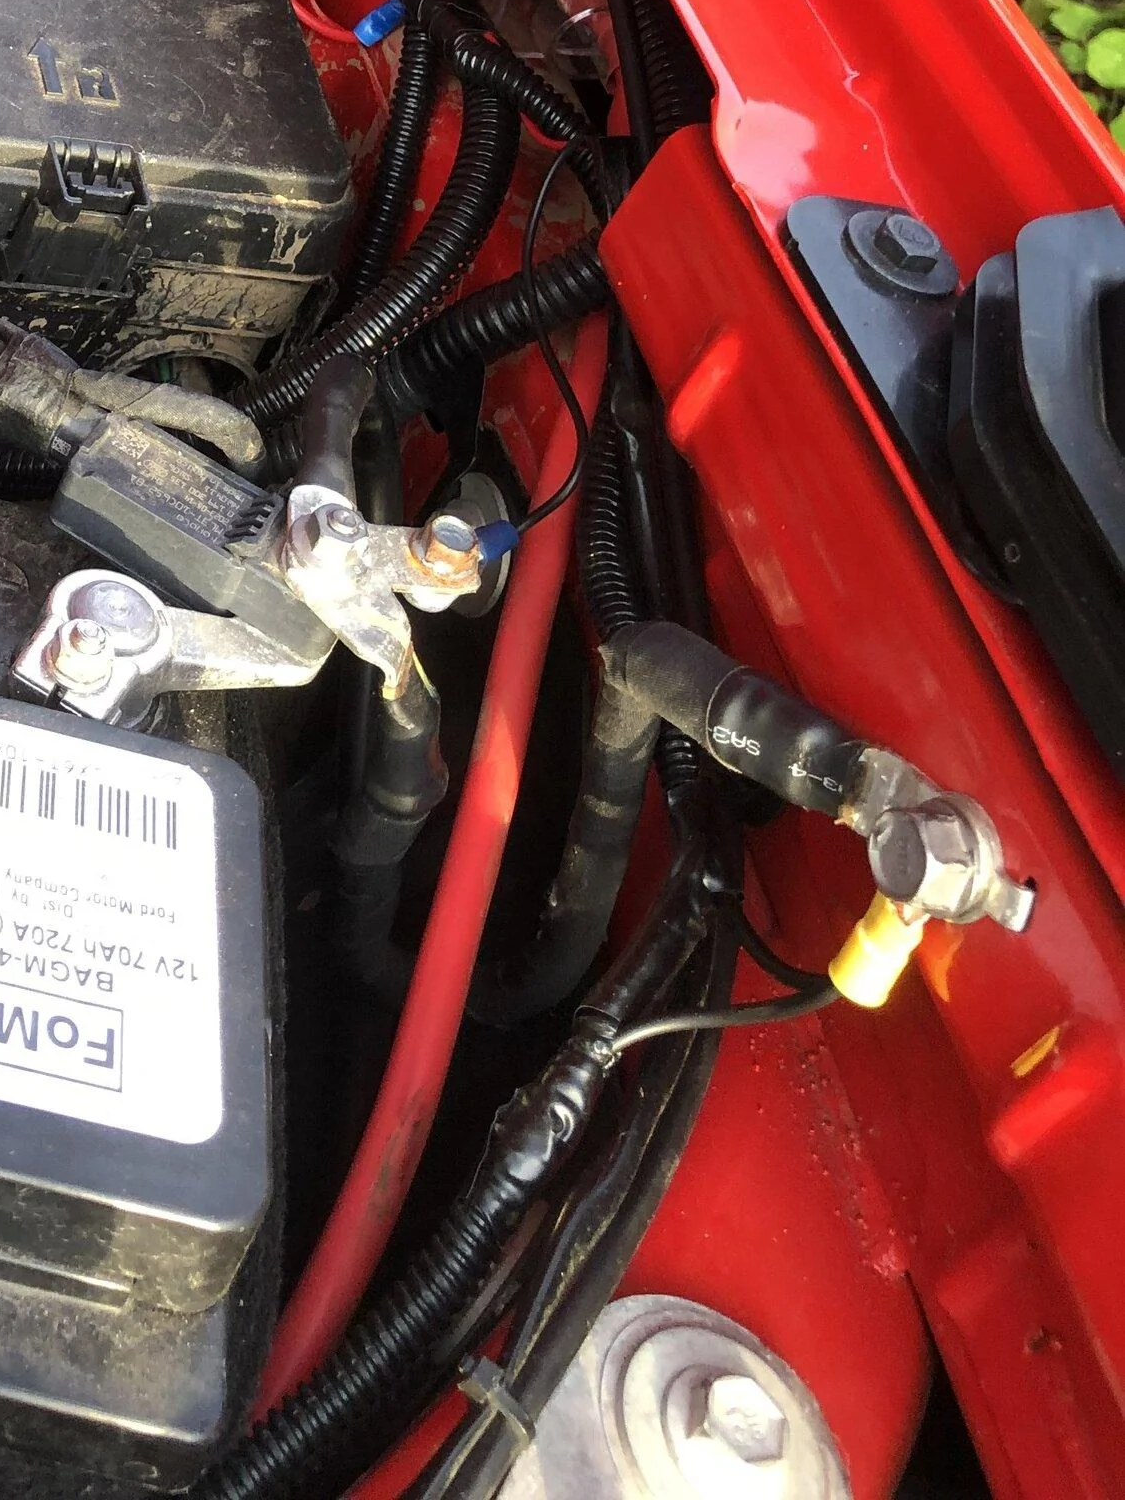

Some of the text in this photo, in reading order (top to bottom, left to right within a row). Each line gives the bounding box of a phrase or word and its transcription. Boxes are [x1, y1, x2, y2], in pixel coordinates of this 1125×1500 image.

[4, 867, 80, 902] Company
[139, 904, 176, 924] Ford
[10, 920, 76, 954] 720A
[81, 937, 148, 971] 70Ah
[155, 954, 201, 982] 12V
